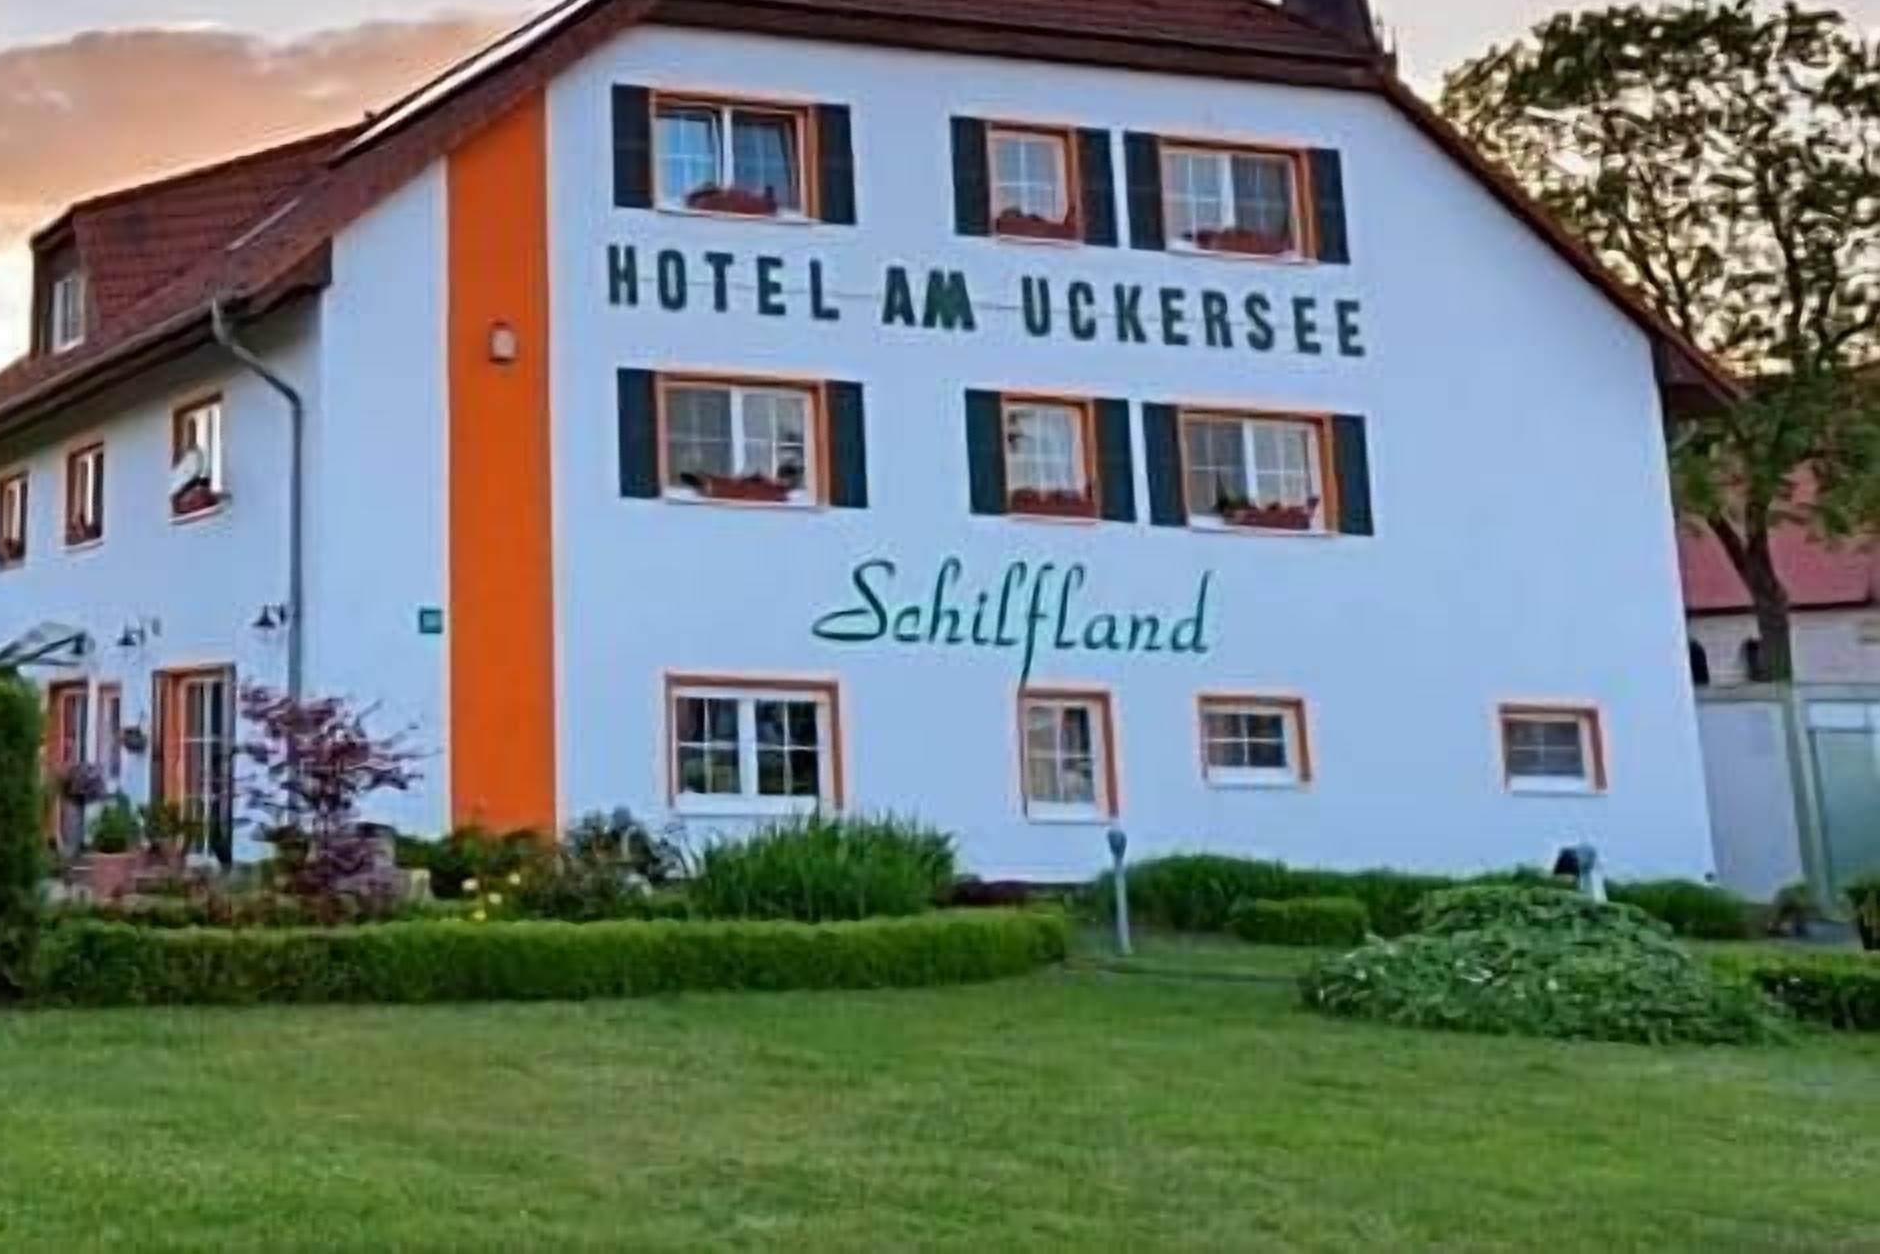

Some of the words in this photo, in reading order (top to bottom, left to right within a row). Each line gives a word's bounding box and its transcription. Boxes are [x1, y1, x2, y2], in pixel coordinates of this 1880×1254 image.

[607, 244, 840, 321] HOTEL
[881, 265, 976, 330] AM
[1020, 276, 1365, 356] UCKERSEE
[811, 557, 1212, 682] Schilfland
